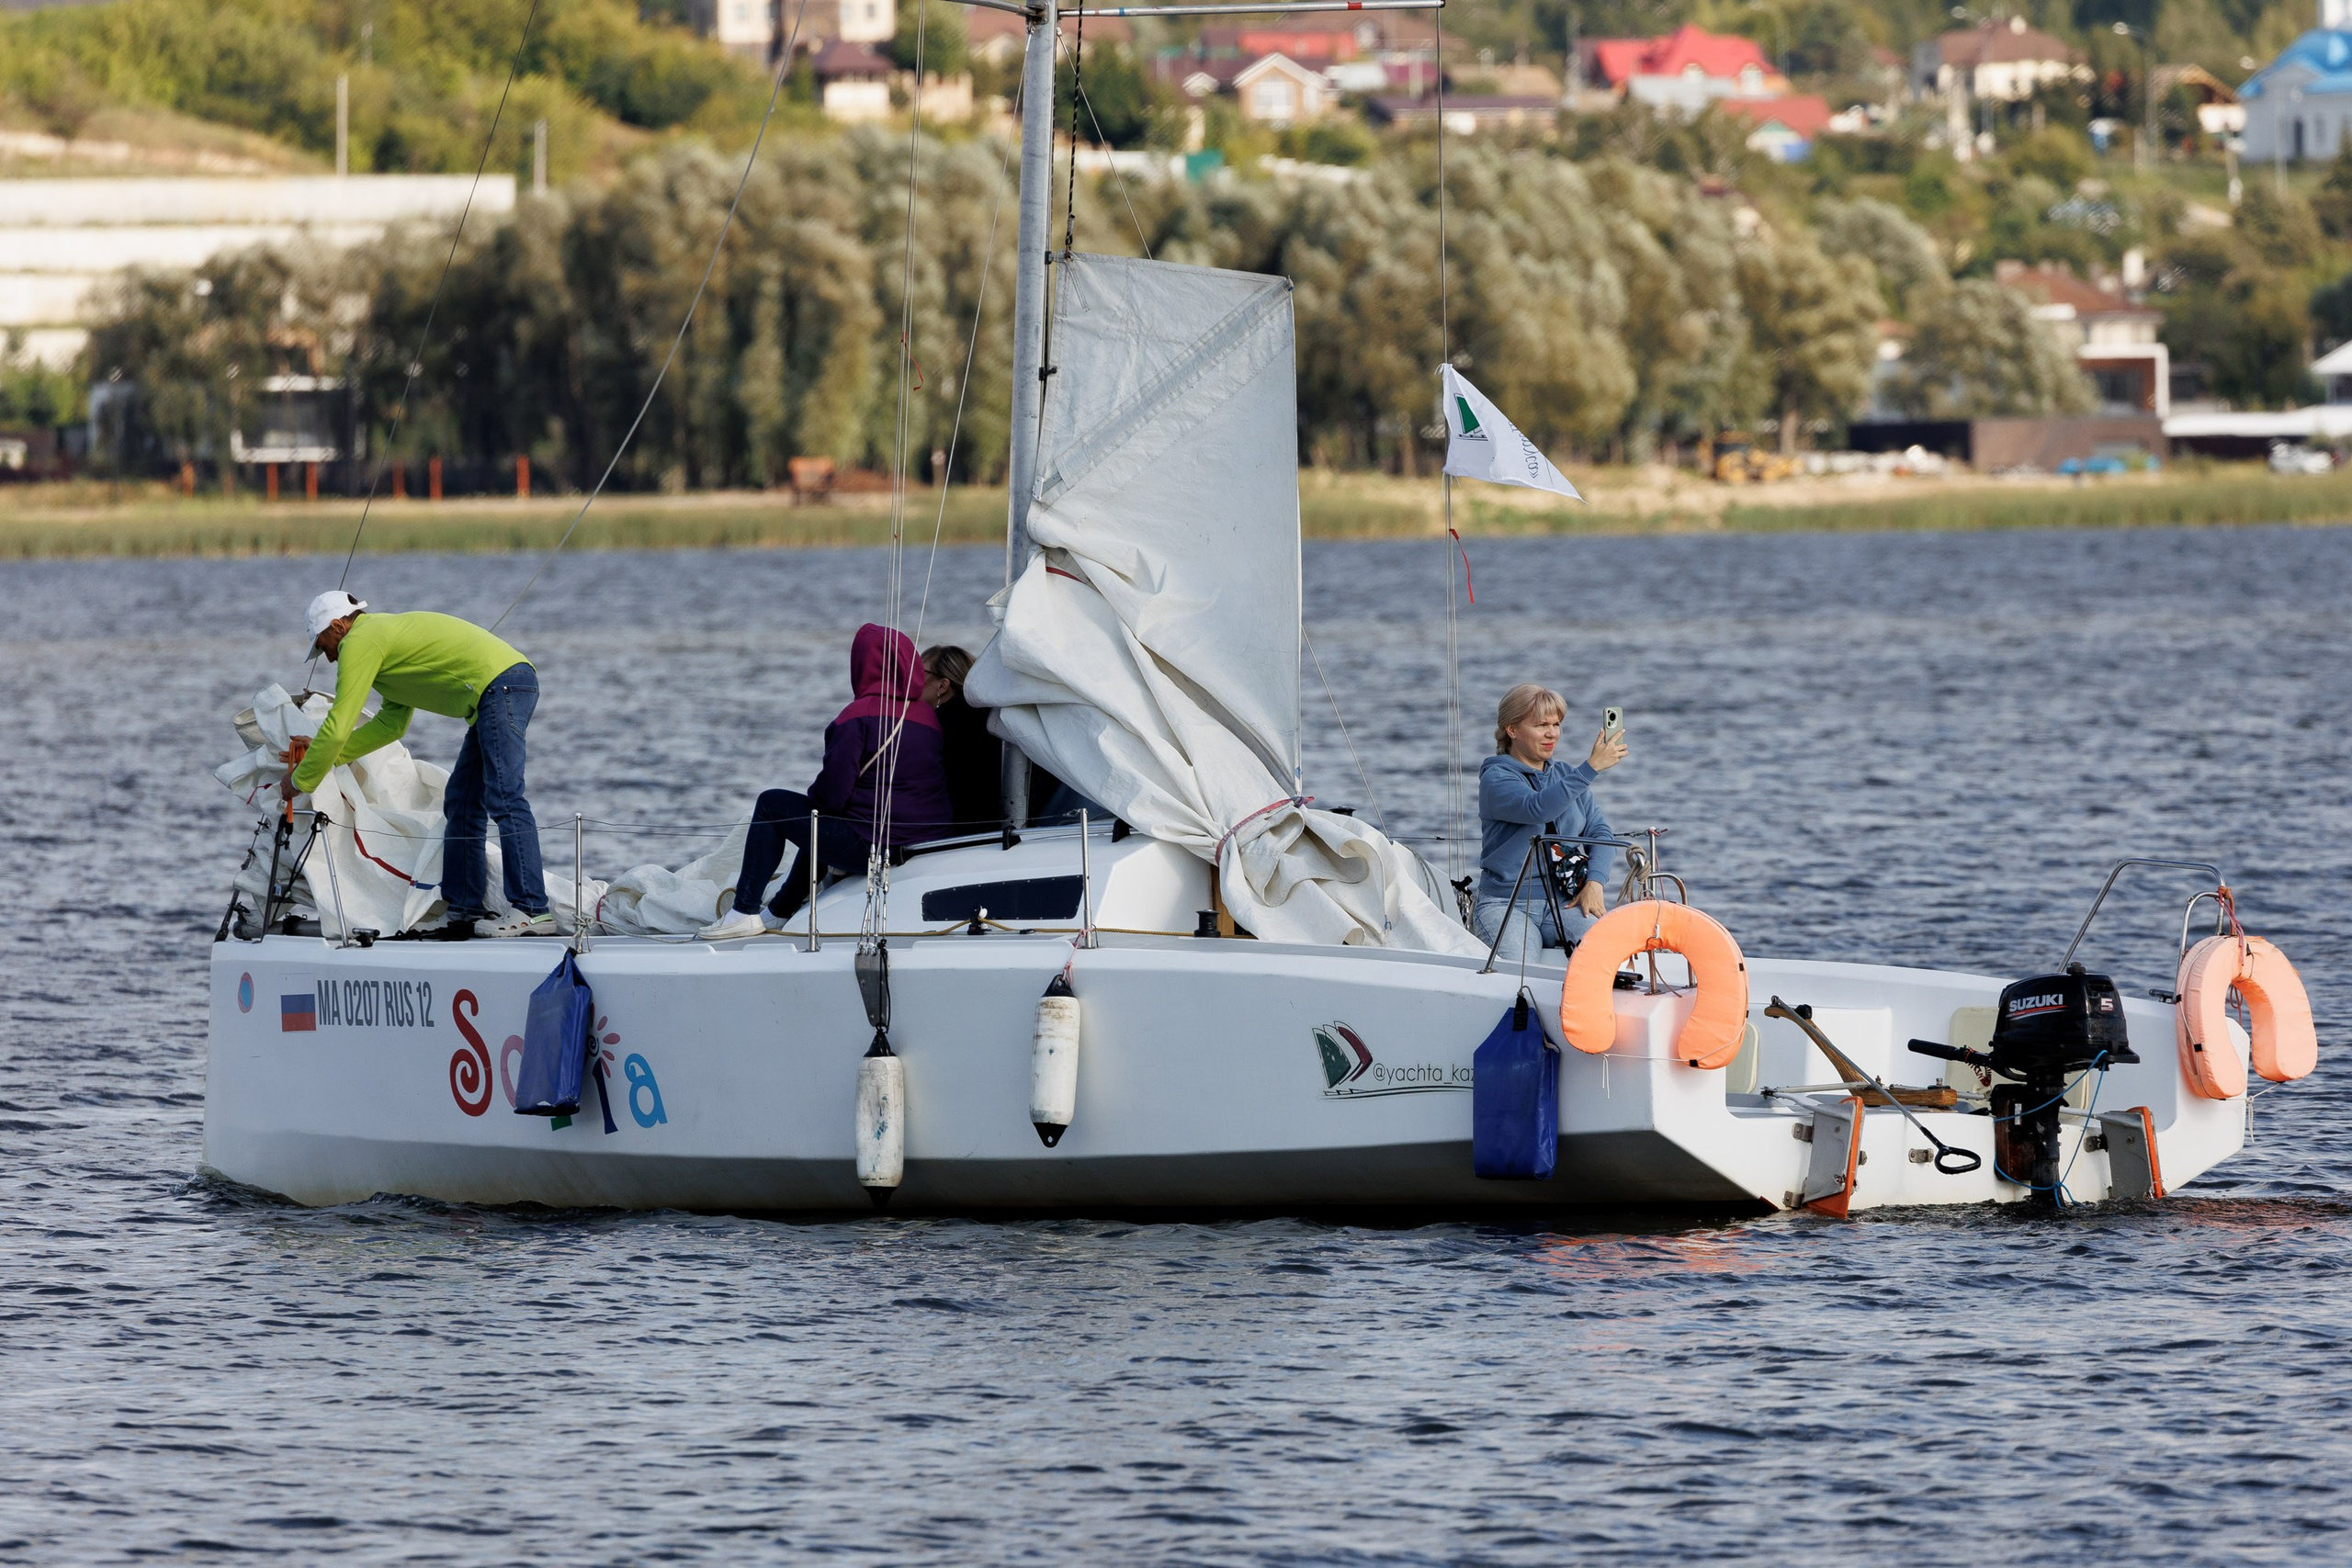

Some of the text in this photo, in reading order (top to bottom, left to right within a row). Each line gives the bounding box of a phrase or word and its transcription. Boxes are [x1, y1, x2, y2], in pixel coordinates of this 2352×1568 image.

[317, 979, 435, 1028] MA 0207 RUS 12
[2008, 993, 2064, 1012] SUZUKI
[2100, 998, 2114, 1011] 5
[449, 988, 668, 1135] Soia
